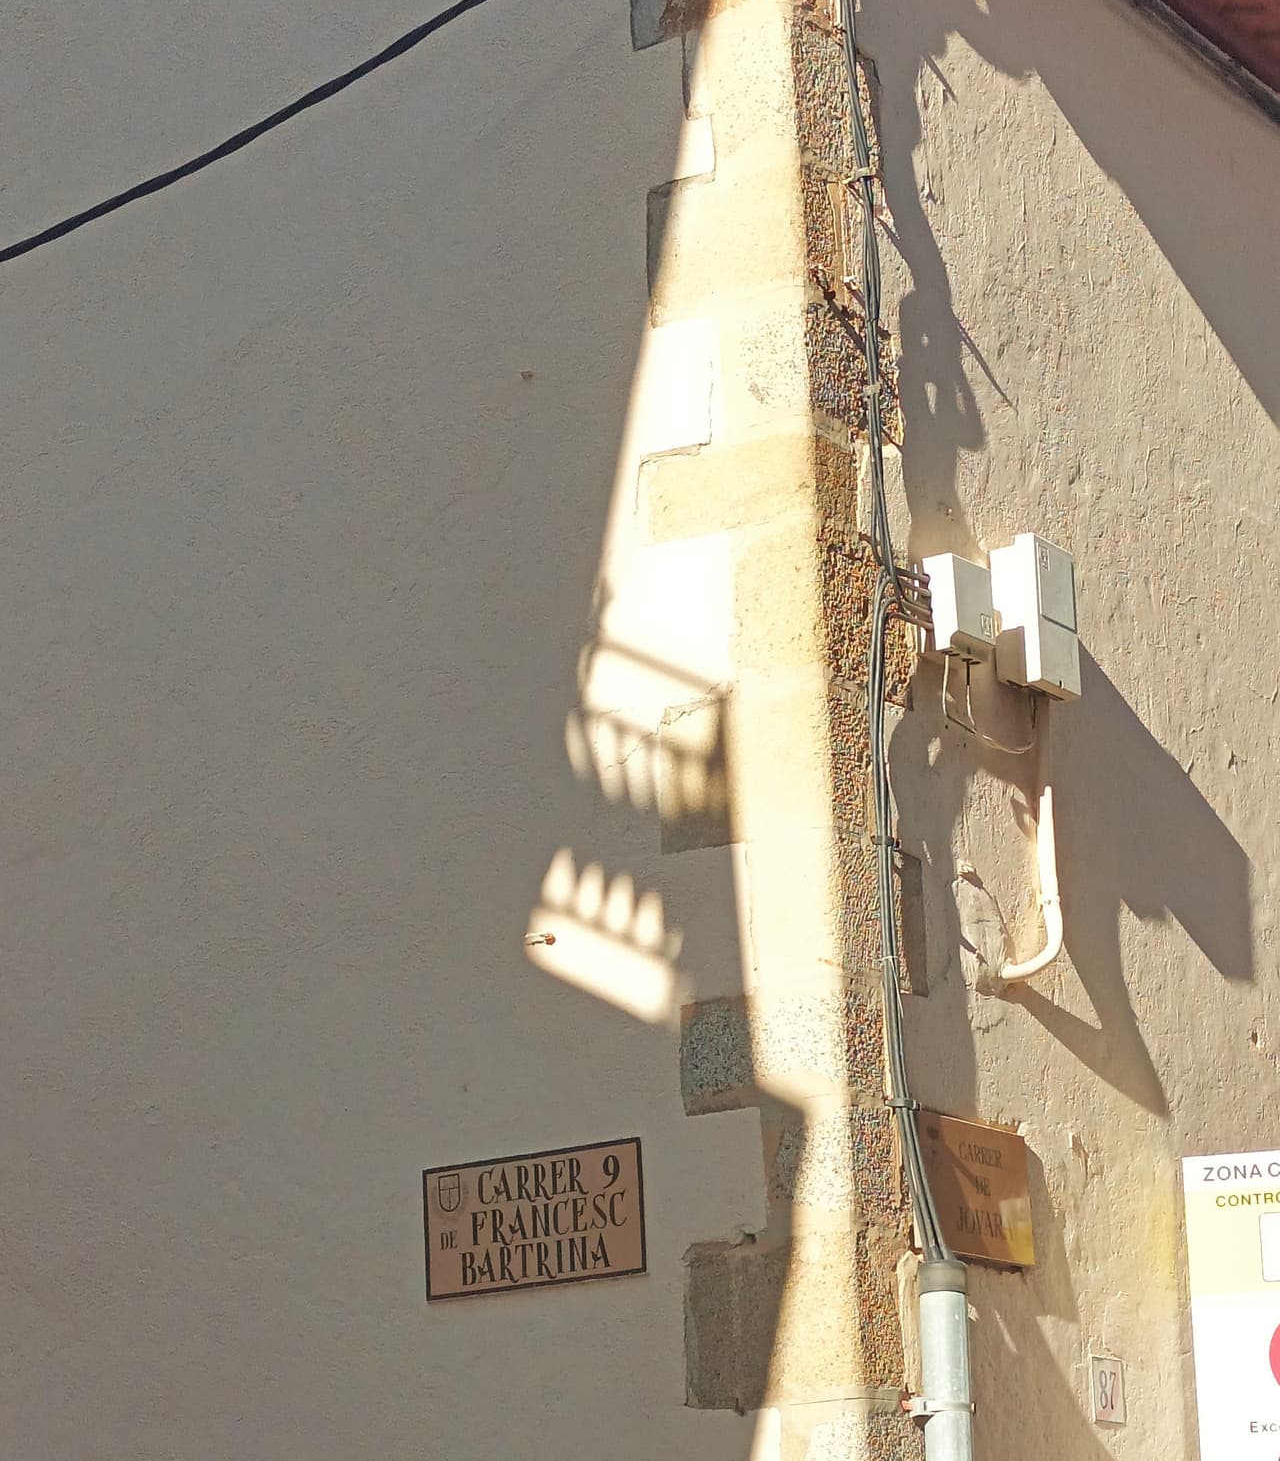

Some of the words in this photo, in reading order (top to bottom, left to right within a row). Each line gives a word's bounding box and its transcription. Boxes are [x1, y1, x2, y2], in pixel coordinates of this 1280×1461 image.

[958, 1141, 1003, 1169] CARRER
[1203, 1164, 1262, 1182] ZONA
[477, 1157, 588, 1205] CARRER
[602, 1154, 621, 1189] 9
[975, 1174, 992, 1196] DE
[440, 1230, 458, 1251] DE
[470, 1189, 628, 1246] FRANCESC
[460, 1233, 611, 1286] BARTRINA
[1099, 1370, 1117, 1410] 87
